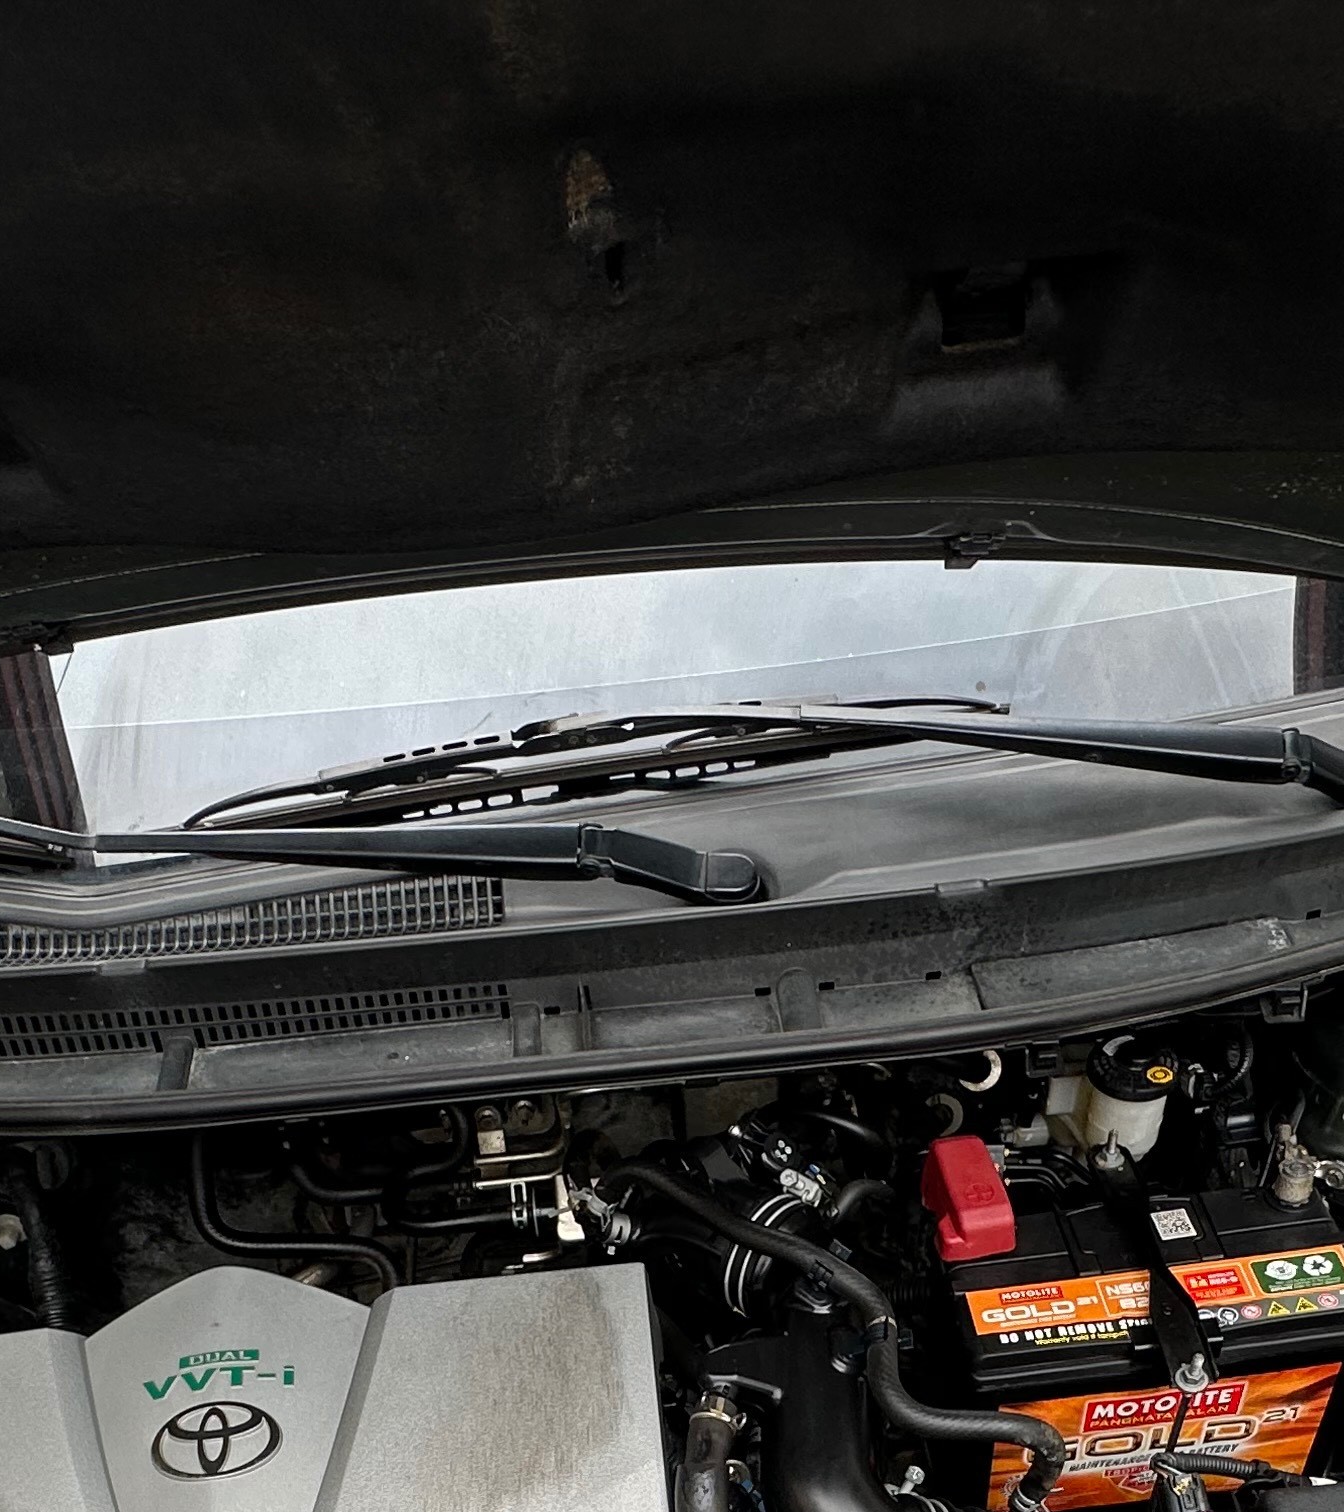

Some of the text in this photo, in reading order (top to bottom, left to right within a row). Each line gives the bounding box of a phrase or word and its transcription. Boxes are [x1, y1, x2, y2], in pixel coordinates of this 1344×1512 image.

[1001, 1287, 1059, 1302] MOTOLITE
[981, 1301, 1076, 1323] GOLD
[999, 1332, 1020, 1345] DO
[1024, 1328, 1052, 1341] NOT
[1057, 1322, 1115, 1337] REMOVE
[189, 1350, 253, 1366] DUAL
[142, 1365, 295, 1401] VVT-i
[1091, 1388, 1234, 1420] MOTOITE
[1259, 1404, 1301, 1423] 21
[1089, 1405, 1230, 1428] PANGMATAALAN
[1106, 1465, 1150, 1476] TROPIC
